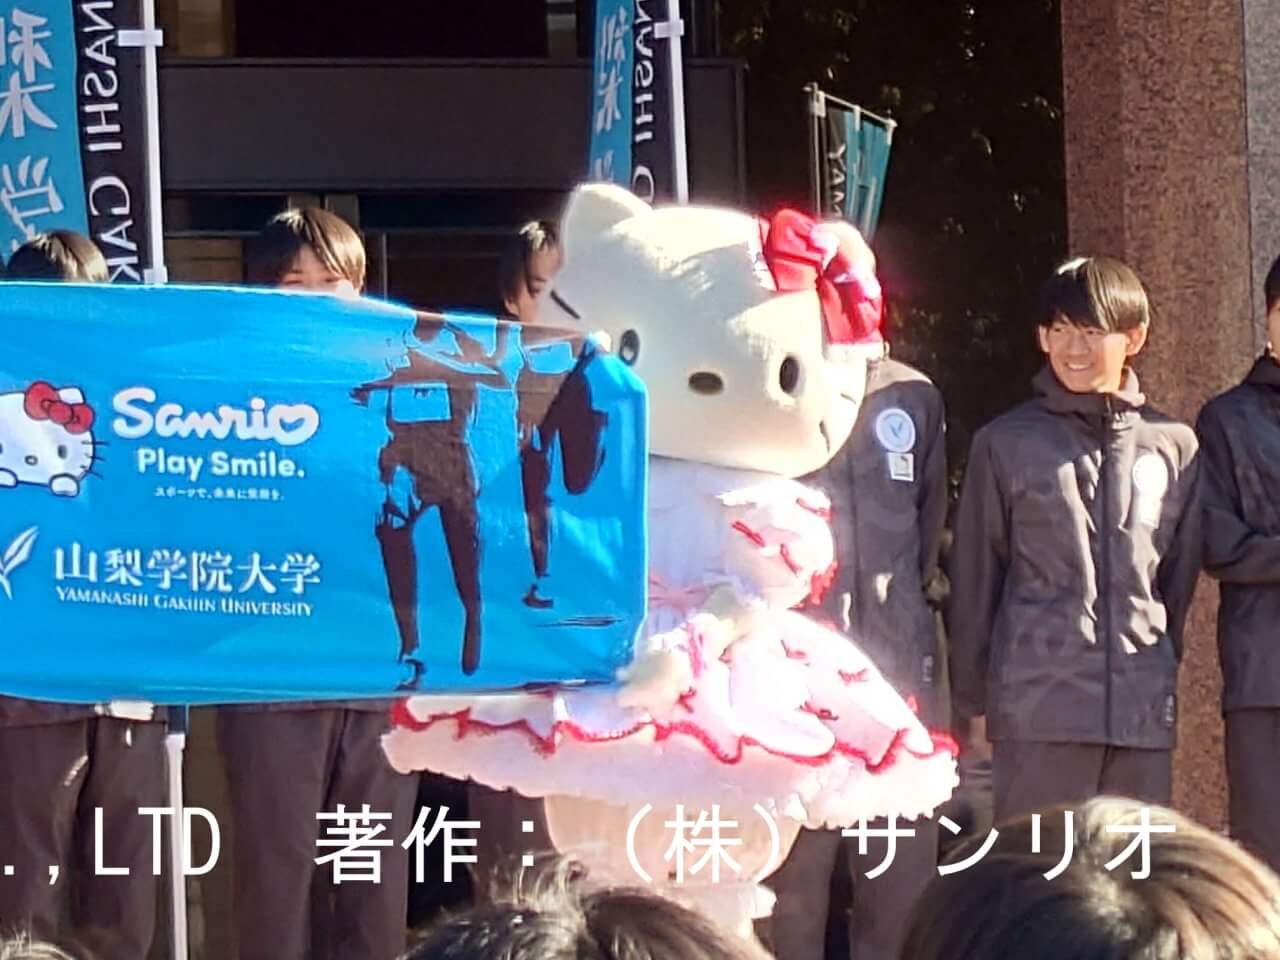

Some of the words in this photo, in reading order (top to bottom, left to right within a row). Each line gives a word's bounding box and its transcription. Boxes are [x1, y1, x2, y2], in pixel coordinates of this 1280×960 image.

[112, 386, 320, 446] Sanrio
[137, 447, 203, 482] Play
[210, 450, 305, 479] Smile.
[54, 541, 321, 595] 山梨学院大学
[55, 585, 148, 608] YAMANASHI
[221, 597, 313, 617] UNIVERSITY
